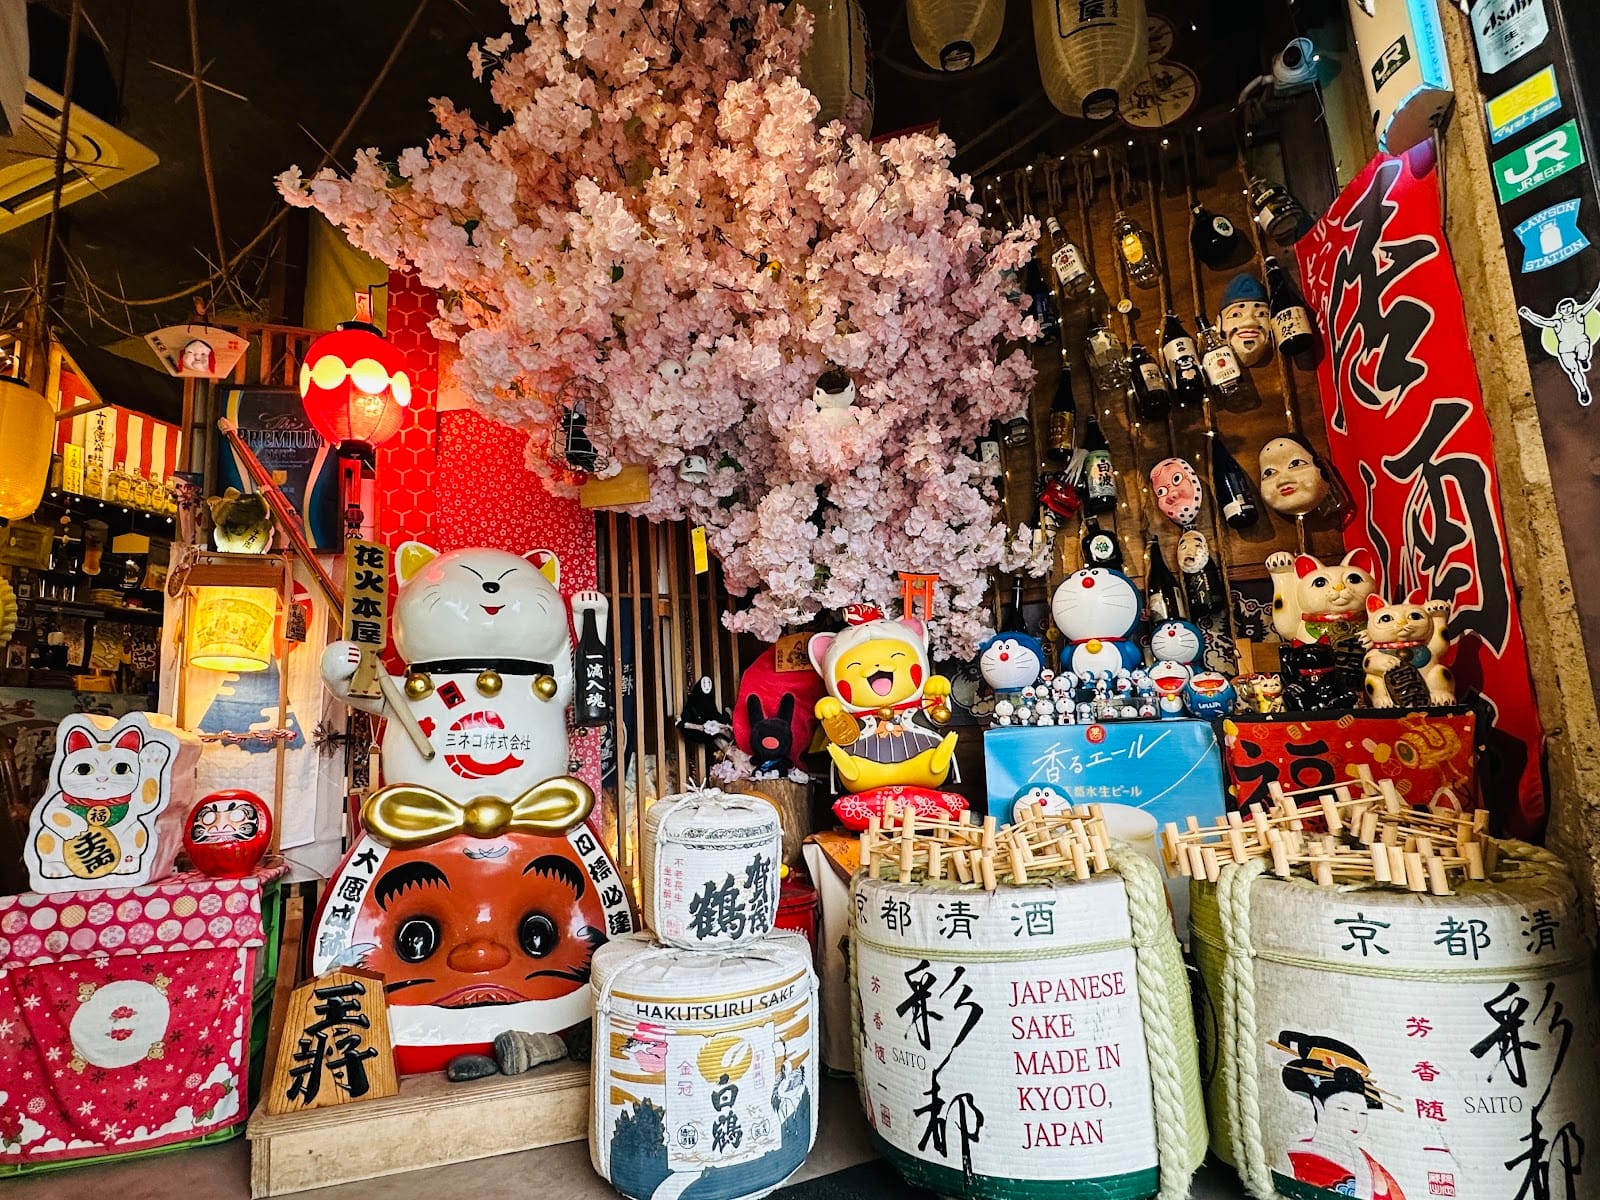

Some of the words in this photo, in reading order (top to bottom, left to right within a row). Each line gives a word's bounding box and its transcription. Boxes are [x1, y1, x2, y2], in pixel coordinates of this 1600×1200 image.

[1373, 41, 1405, 78] JR
[1504, 129, 1572, 185] JR
[1516, 162, 1566, 193] JR東日本
[1518, 201, 1577, 234] LAWSON
[1524, 239, 1586, 273] STATION
[1097, 459, 1113, 488] 白波
[350, 544, 385, 646] 花火本屋
[585, 653, 607, 709] 一滴入魂
[1028, 728, 1172, 784] 香るエール
[1065, 785, 1143, 799] 然水生ビール
[90, 807, 108, 823] 福
[1334, 908, 1561, 961] 京都清
[1008, 971, 1127, 1008] JAPANESE
[636, 997, 754, 1021] HAKUTSURU
[286, 980, 378, 1105] 王将
[1011, 1013, 1075, 1041] SAKE
[892, 1046, 927, 1071] SAITO
[1014, 1048, 1091, 1075] MADE
[1096, 1043, 1122, 1070] IN
[676, 1060, 694, 1097] 金冠
[710, 1073, 743, 1153] 白鶴
[1017, 1082, 1113, 1112] KYOTO,
[1464, 1095, 1524, 1115] SAITO
[1022, 1119, 1104, 1150] JAPAN
